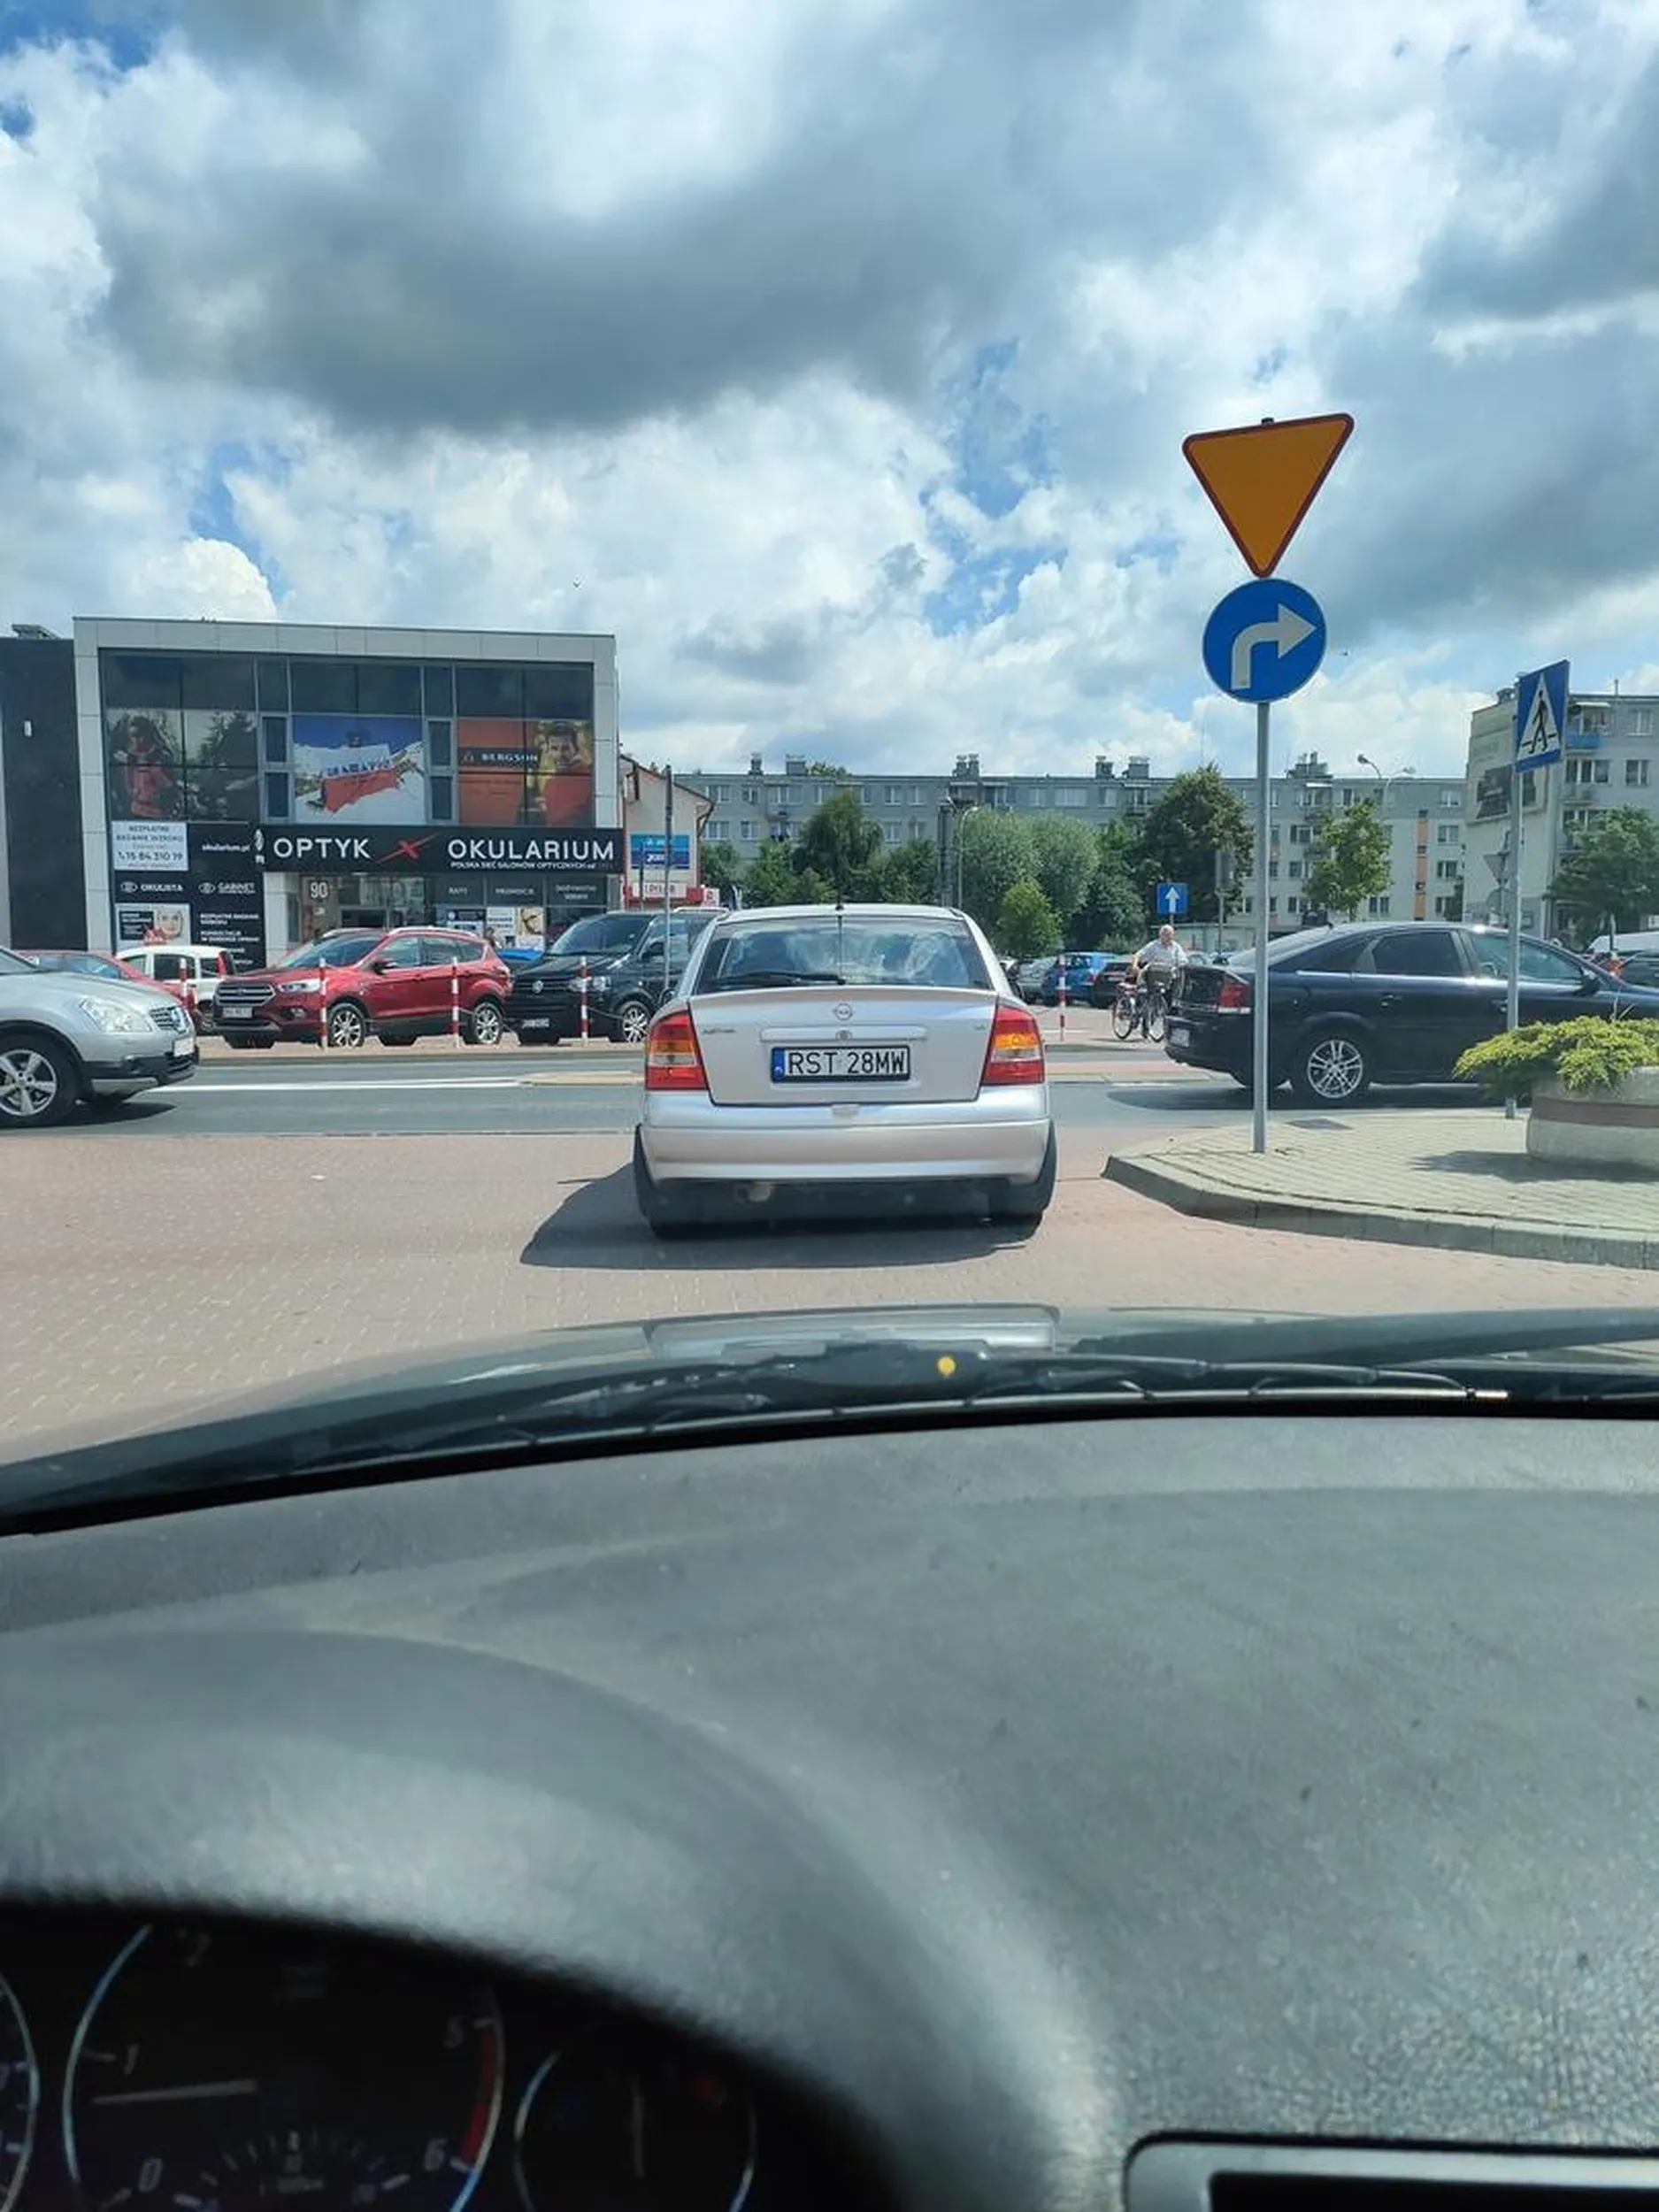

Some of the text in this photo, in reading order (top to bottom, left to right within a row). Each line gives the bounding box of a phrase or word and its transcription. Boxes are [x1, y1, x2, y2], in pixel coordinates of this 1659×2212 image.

[481, 753, 538, 762] BERGSON
[273, 838, 371, 859] OPTYK
[448, 839, 615, 860] OKULARIUM
[311, 882, 328, 898] 90
[788, 1051, 904, 1074] RST 28MW
[425, 2138, 447, 2172] 6
[138, 2157, 163, 2193] 0
